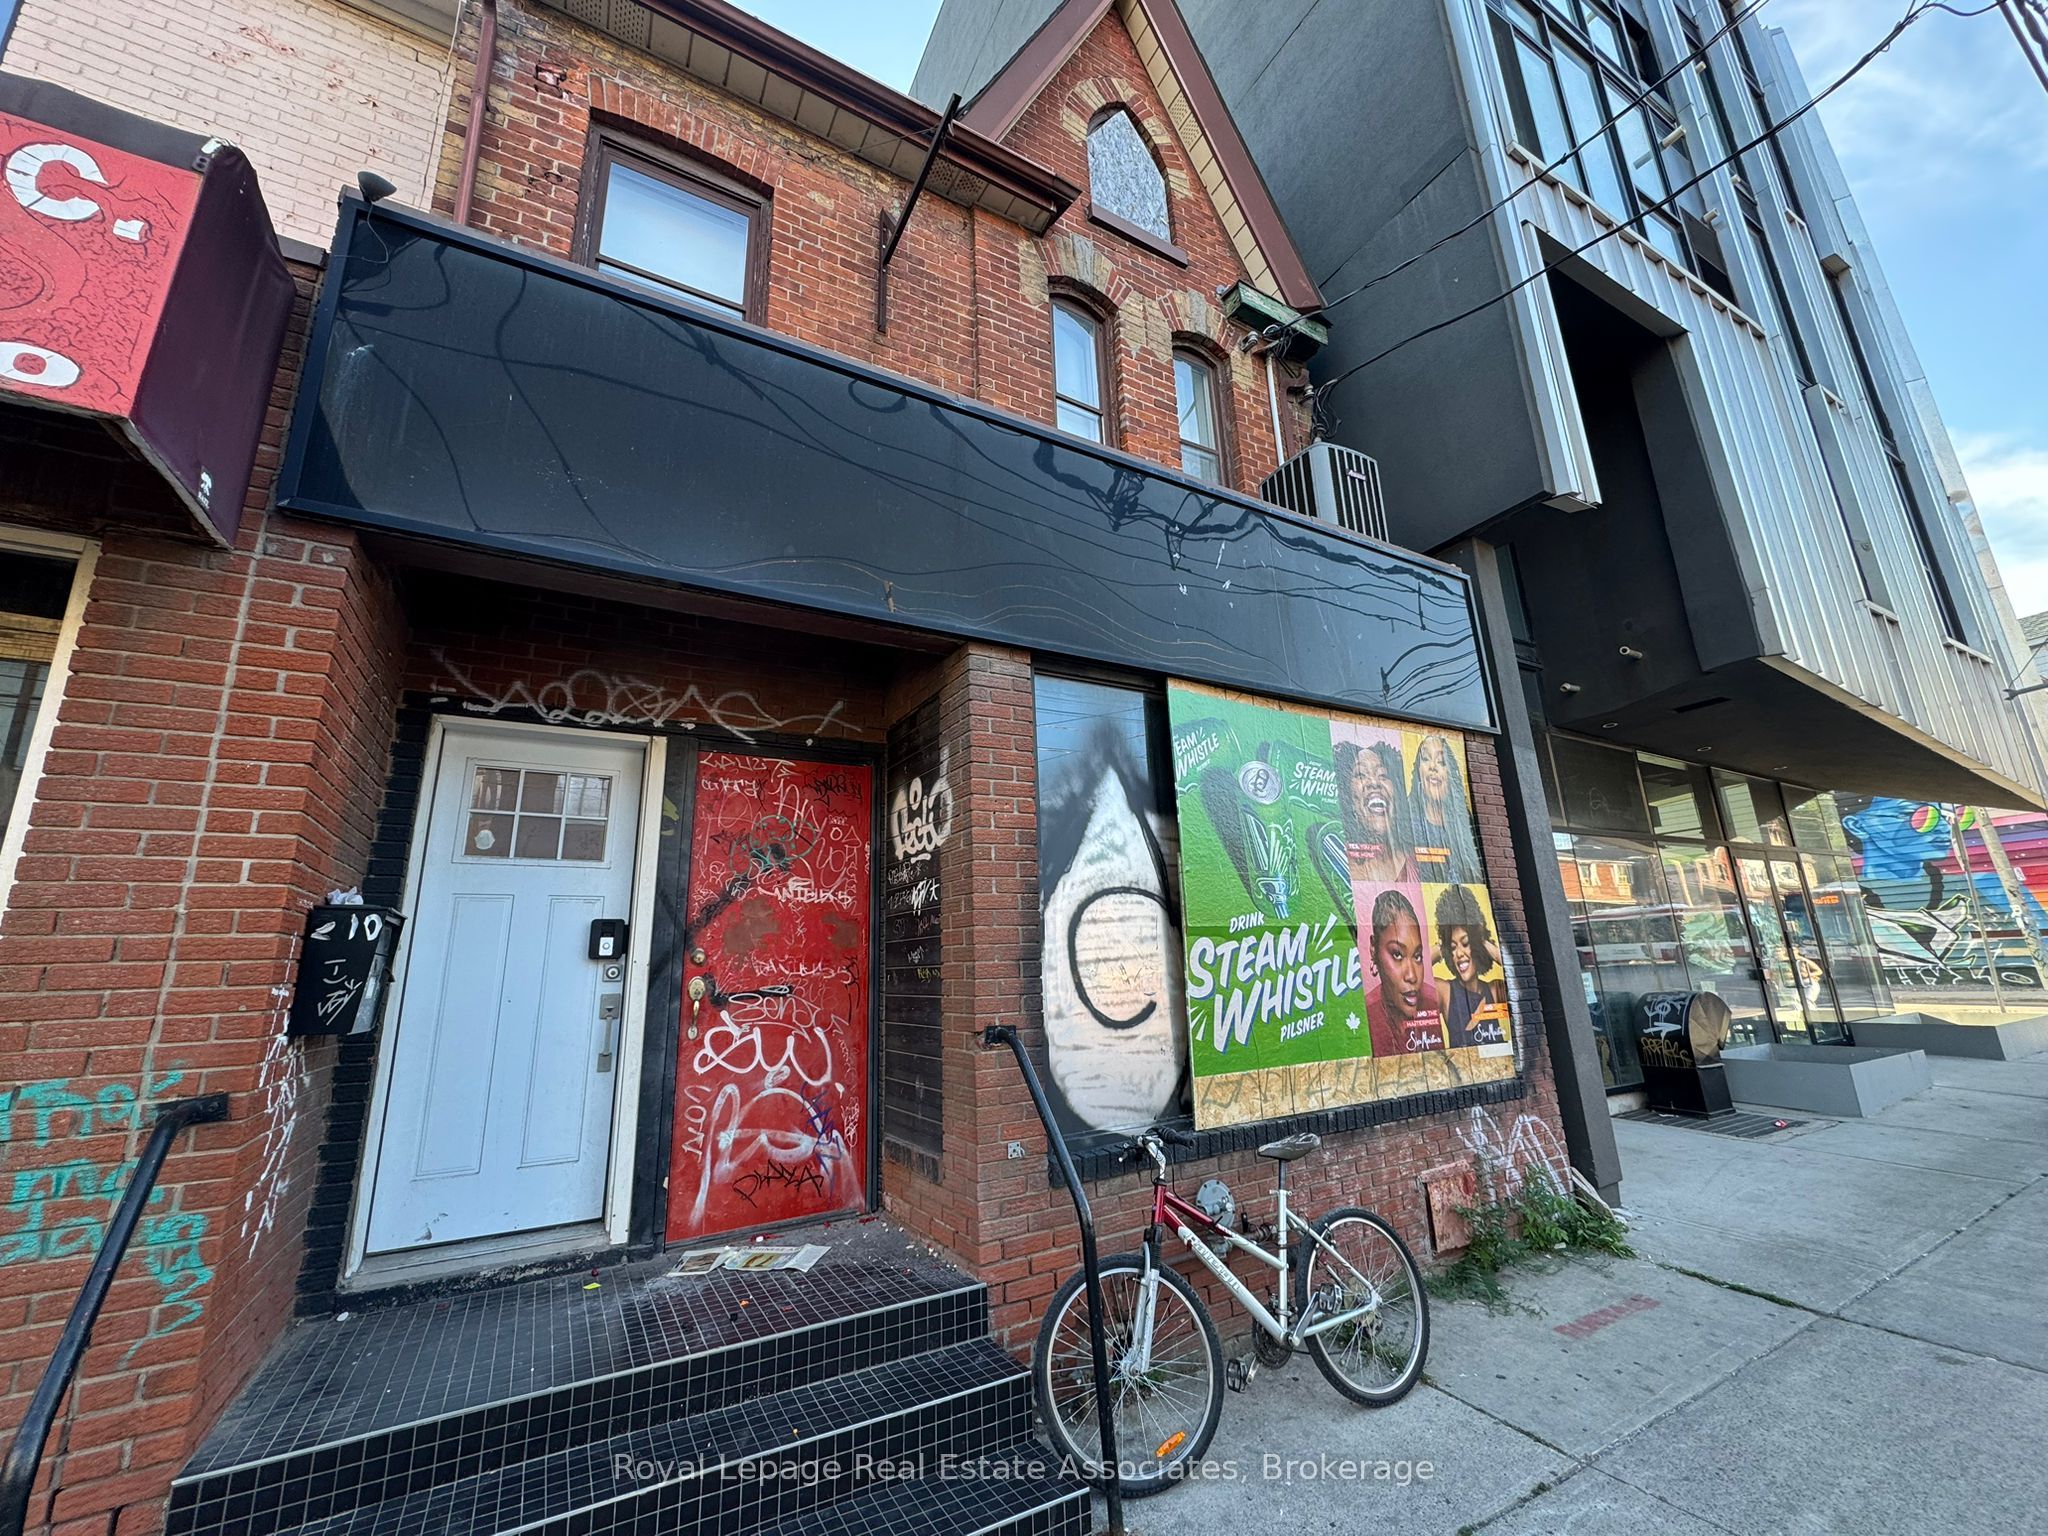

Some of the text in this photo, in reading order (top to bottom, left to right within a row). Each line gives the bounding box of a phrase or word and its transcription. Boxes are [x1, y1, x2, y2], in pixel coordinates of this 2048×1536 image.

[1175, 732, 1219, 781] WHISTLE
[1293, 761, 1336, 782] STEAM
[1229, 911, 1265, 934] DRINK
[1188, 922, 1310, 999] STEAM
[1213, 946, 1362, 1053] WHISTLE
[1280, 1011, 1325, 1043] PILSNER
